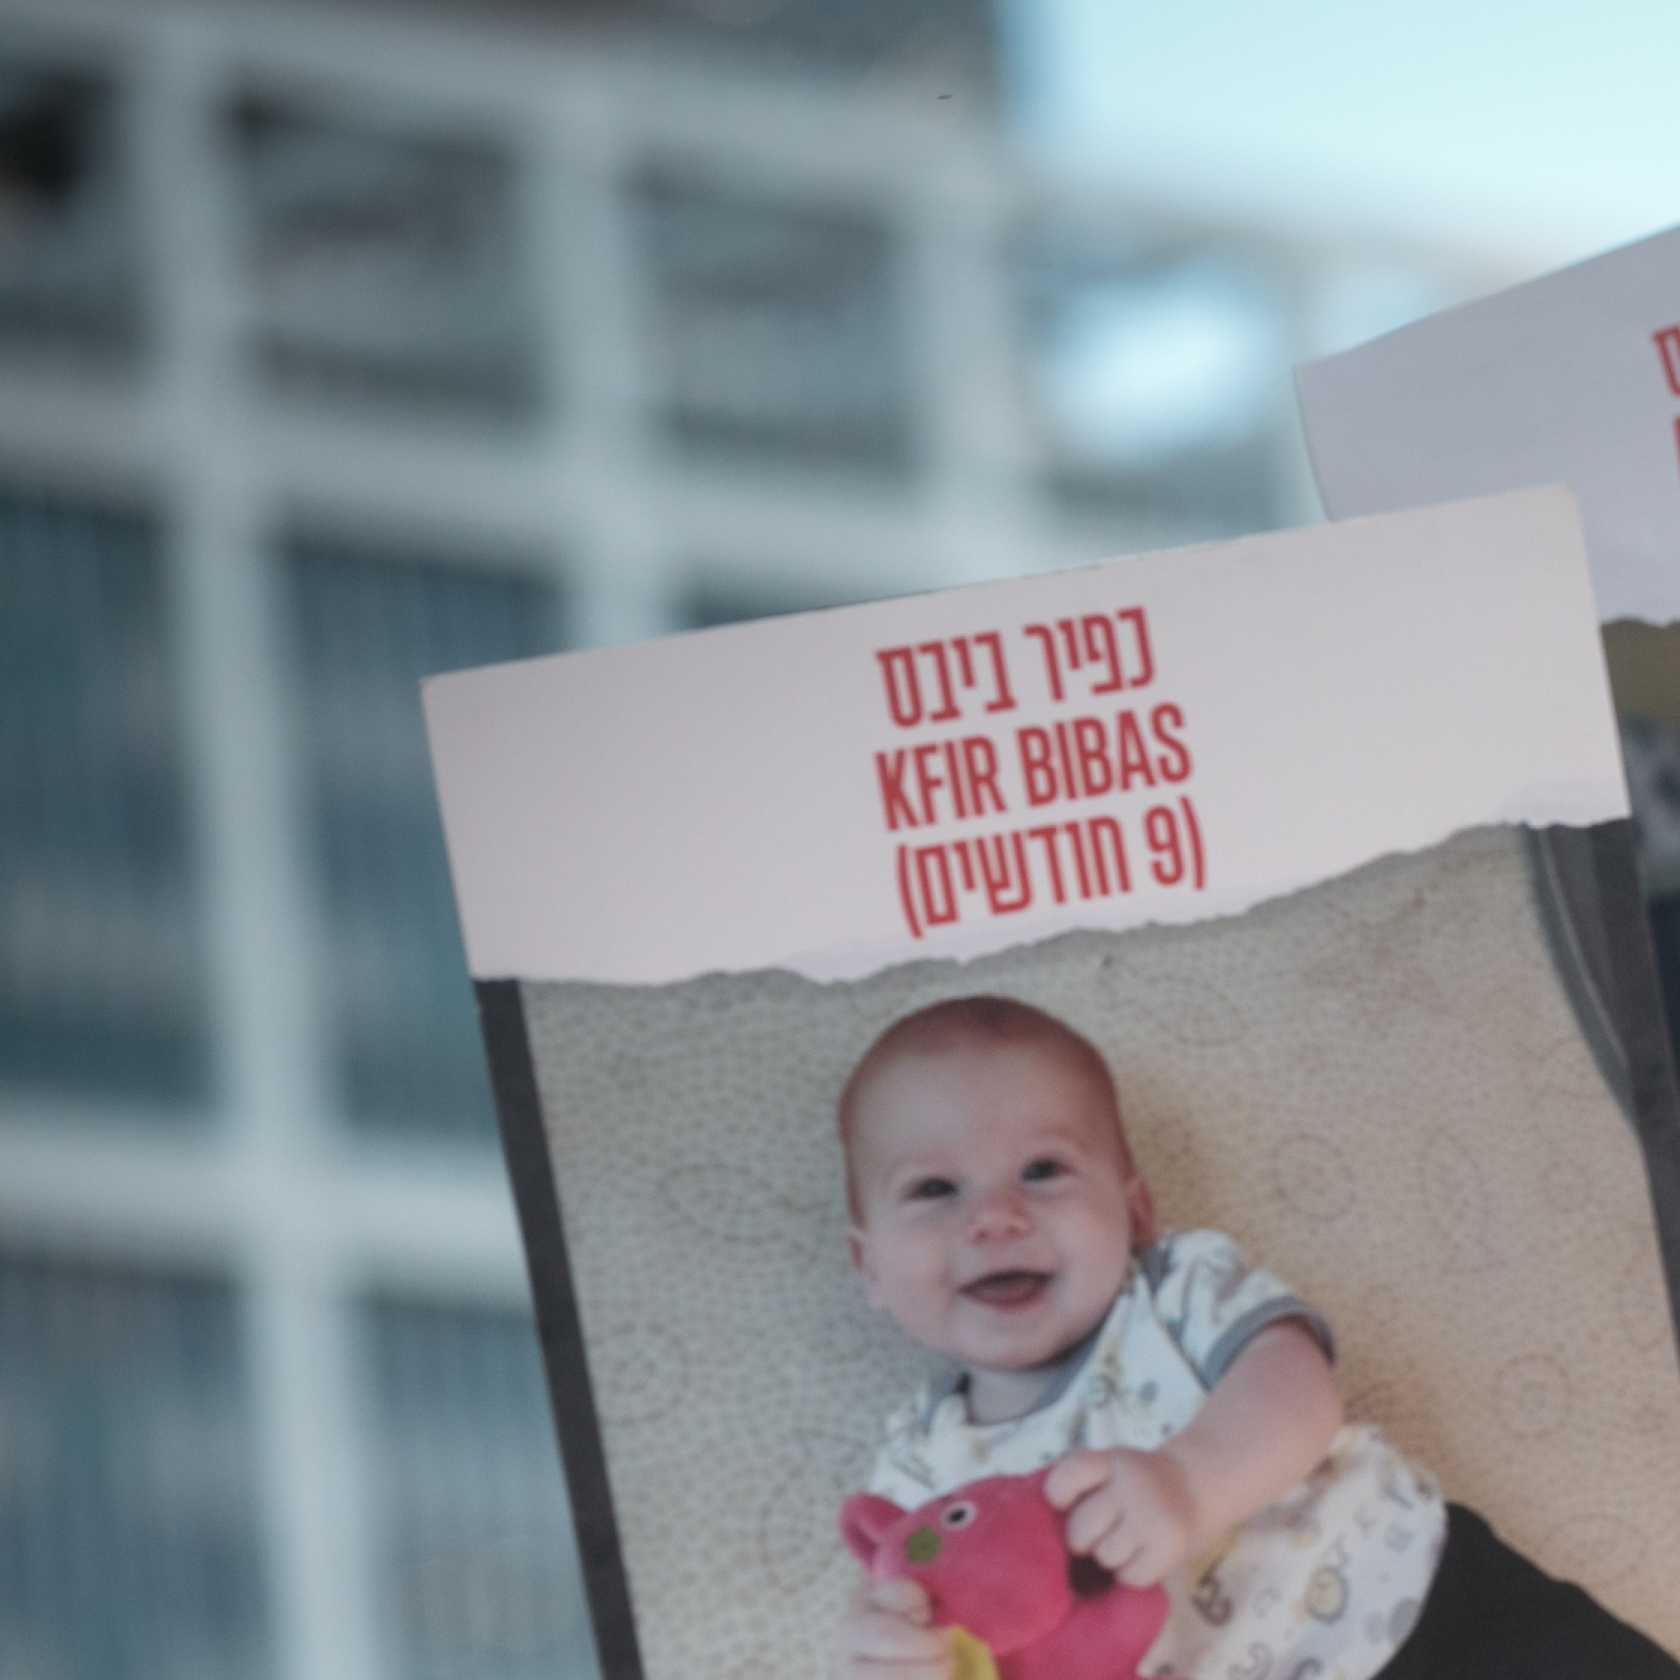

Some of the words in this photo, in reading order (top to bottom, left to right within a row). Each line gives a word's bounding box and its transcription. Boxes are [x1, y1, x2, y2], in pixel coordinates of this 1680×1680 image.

[875, 630, 1017, 729] ביבס
[1022, 605, 1155, 703] כפיר
[874, 733, 1007, 832] KFIR
[1015, 702, 1193, 808] BIBAS
